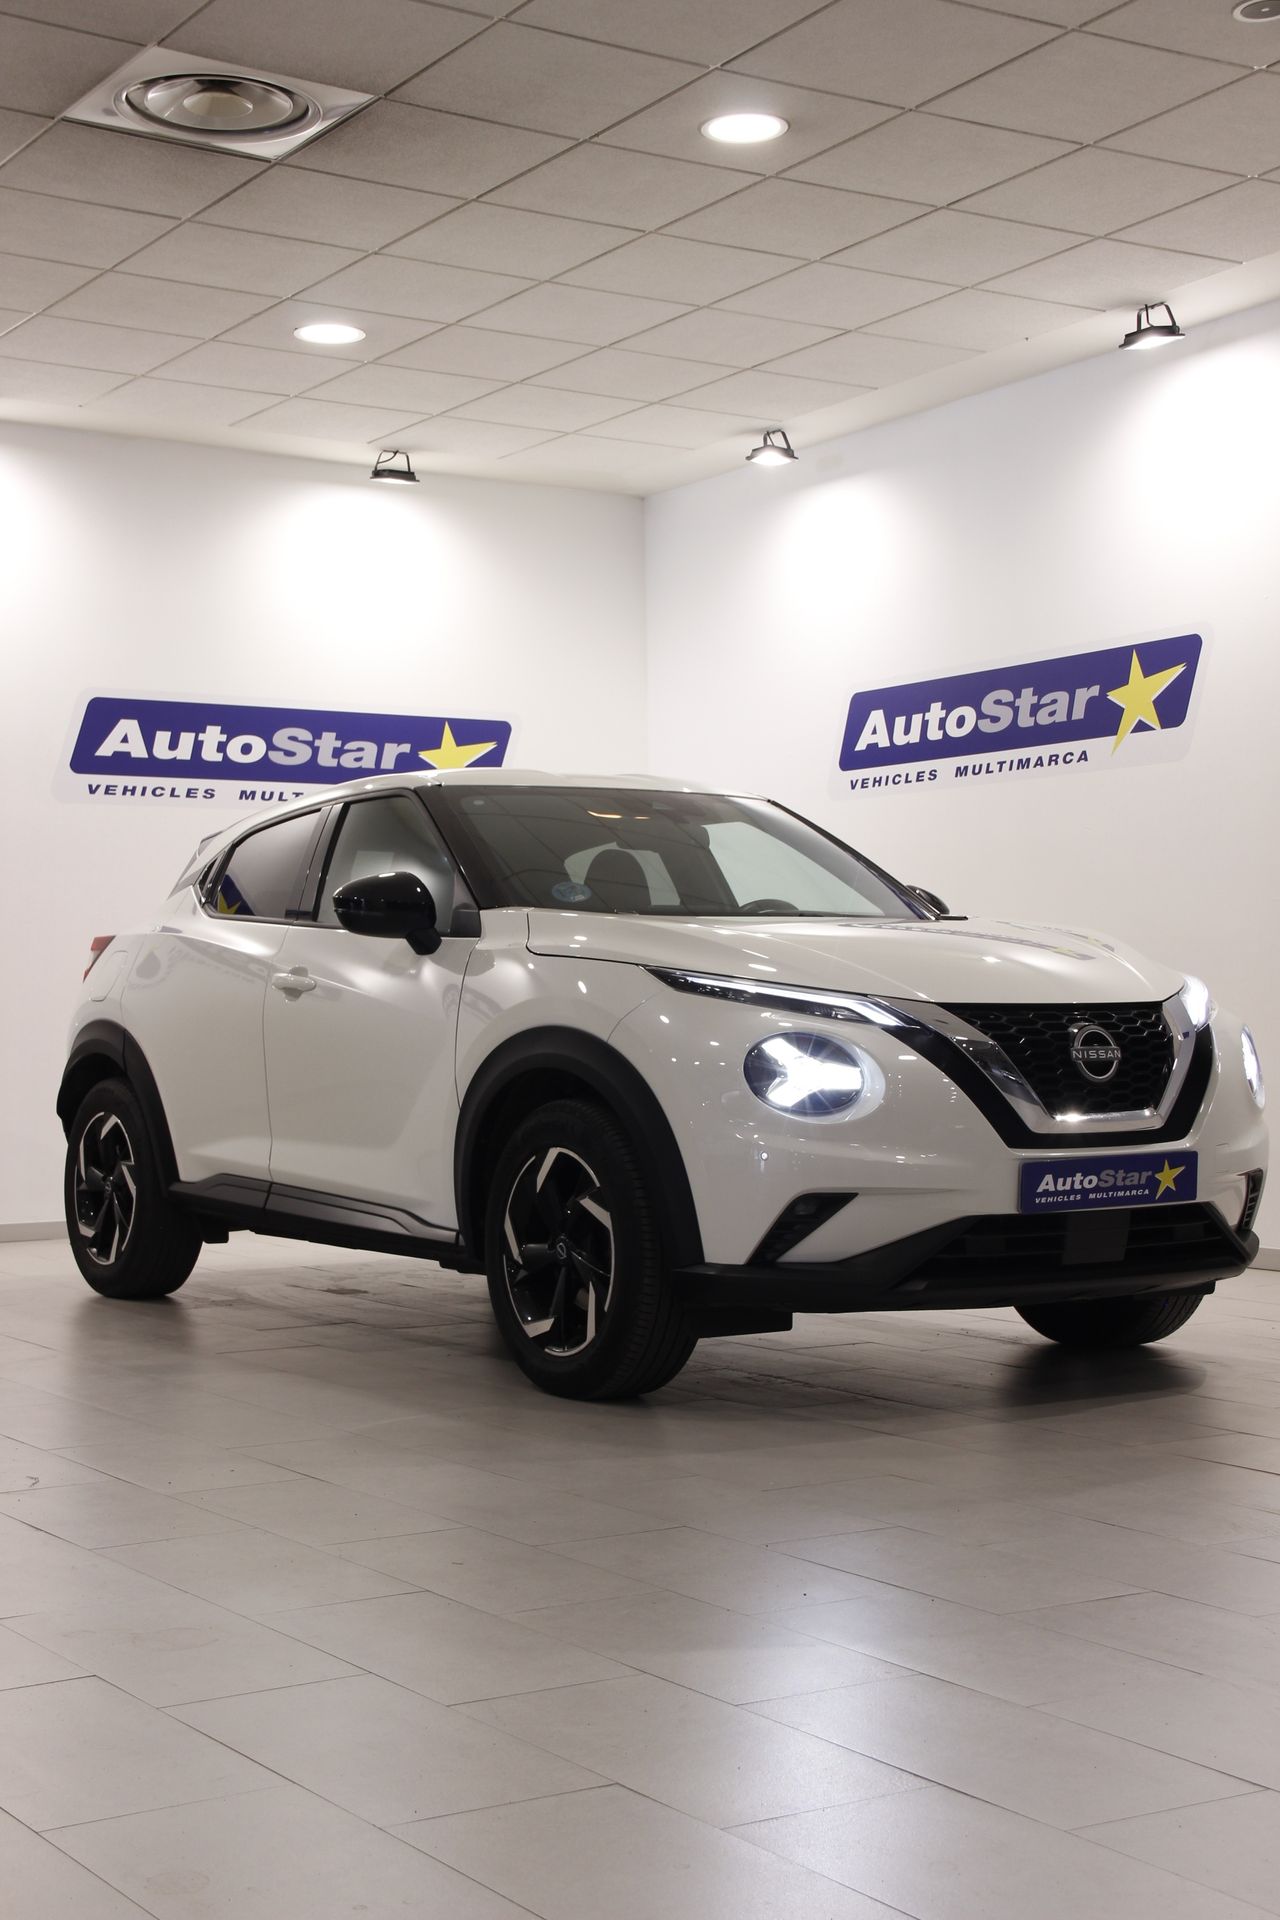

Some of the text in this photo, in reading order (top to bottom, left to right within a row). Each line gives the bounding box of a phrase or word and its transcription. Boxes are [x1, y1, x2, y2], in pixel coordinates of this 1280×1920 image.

[854, 684, 1100, 752] AutoStar
[94, 718, 411, 770] AutoStar
[850, 750, 1090, 791] VEHICLES MULTIMARCA
[87, 783, 217, 800] VEHICLES
[1072, 1049, 1121, 1059] NISSAN
[1036, 1168, 1152, 1193] AutoStar
[1035, 1189, 1150, 1204] VEHICLES MULTIMARCA
